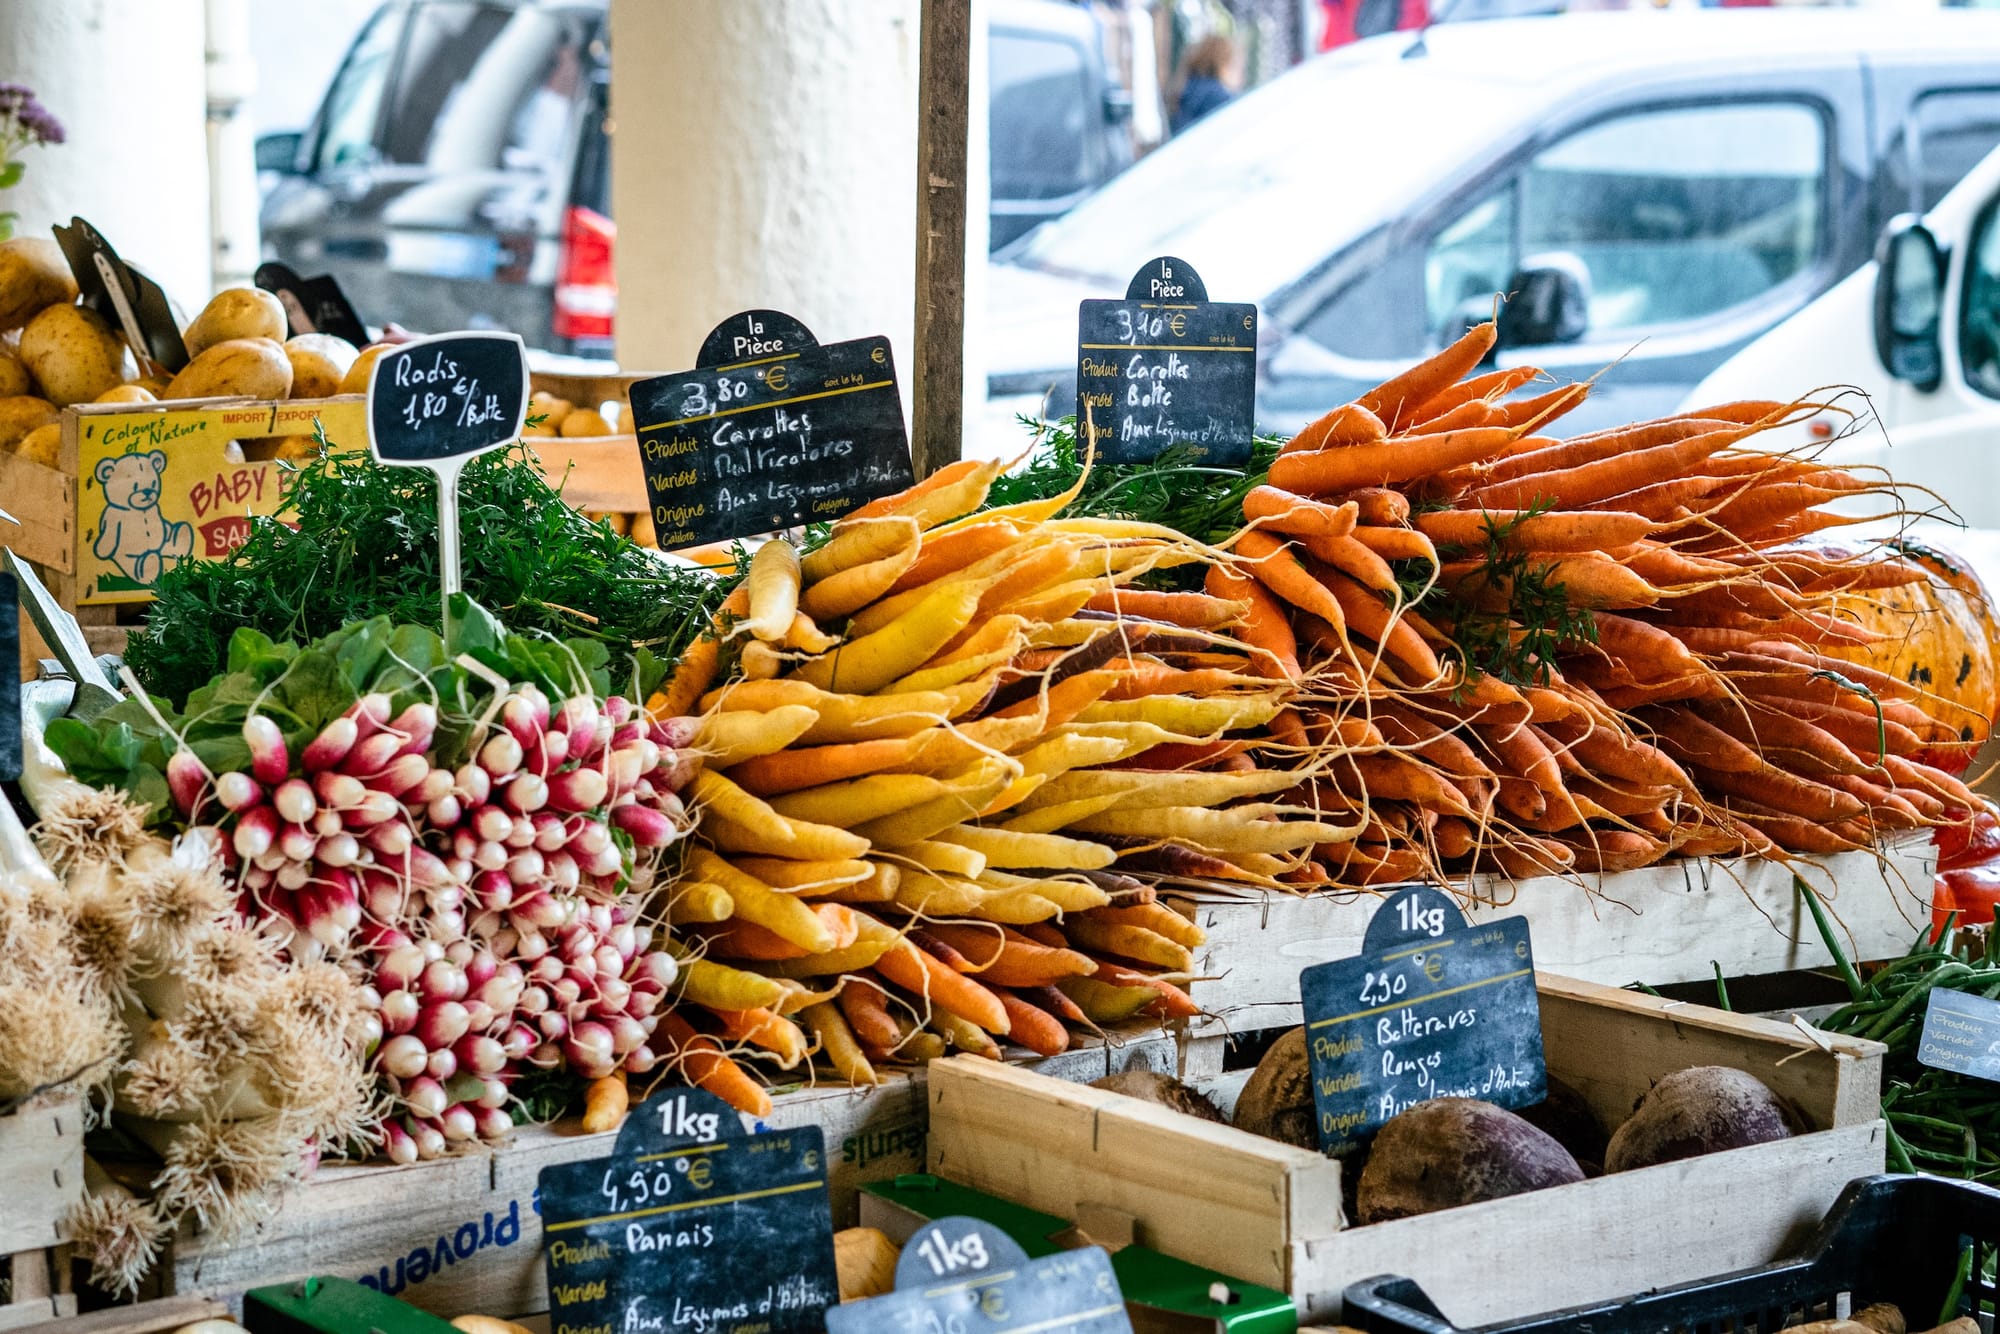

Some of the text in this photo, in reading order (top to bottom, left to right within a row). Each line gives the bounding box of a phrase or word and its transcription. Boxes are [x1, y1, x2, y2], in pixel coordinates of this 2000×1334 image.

[1161, 260, 1173, 280] la
[1151, 279, 1184, 298] Pièce
[747, 314, 764, 335] la
[1117, 309, 1187, 346] 3,10 €
[1243, 315, 1253, 330] €
[733, 337, 784, 357] Pièce
[871, 347, 886, 363] €
[395, 351, 458, 387] Radis
[851, 372, 864, 386] kg
[1081, 357, 1119, 378] Produit
[681, 365, 789, 417] 3,80 €
[223, 409, 322, 424] IMPORT EXPORT
[402, 391, 448, 431] 1,80
[102, 417, 167, 446] Colours
[125, 420, 207, 454] of Nature
[643, 435, 700, 461] Produit
[649, 468, 698, 492] Variété
[188, 466, 267, 529] BABY
[656, 503, 705, 527] Origine
[718, 487, 758, 512] Aux
[1396, 894, 1446, 937] 1kg
[1514, 941, 1528, 959] €
[1359, 954, 1445, 1007] 2,90 €
[1927, 1029, 1975, 1046] Variété
[1931, 1014, 1984, 1034] Produit
[1313, 1034, 1364, 1063] Produit
[1317, 1071, 1362, 1097] Variété
[657, 1094, 720, 1143] 1kg
[1322, 1109, 1367, 1137] Origine
[687, 1158, 715, 1190] €
[550, 1222, 715, 1269] Produit Panais
[917, 1228, 990, 1276] 1kg
[552, 1280, 607, 1307] Variété
